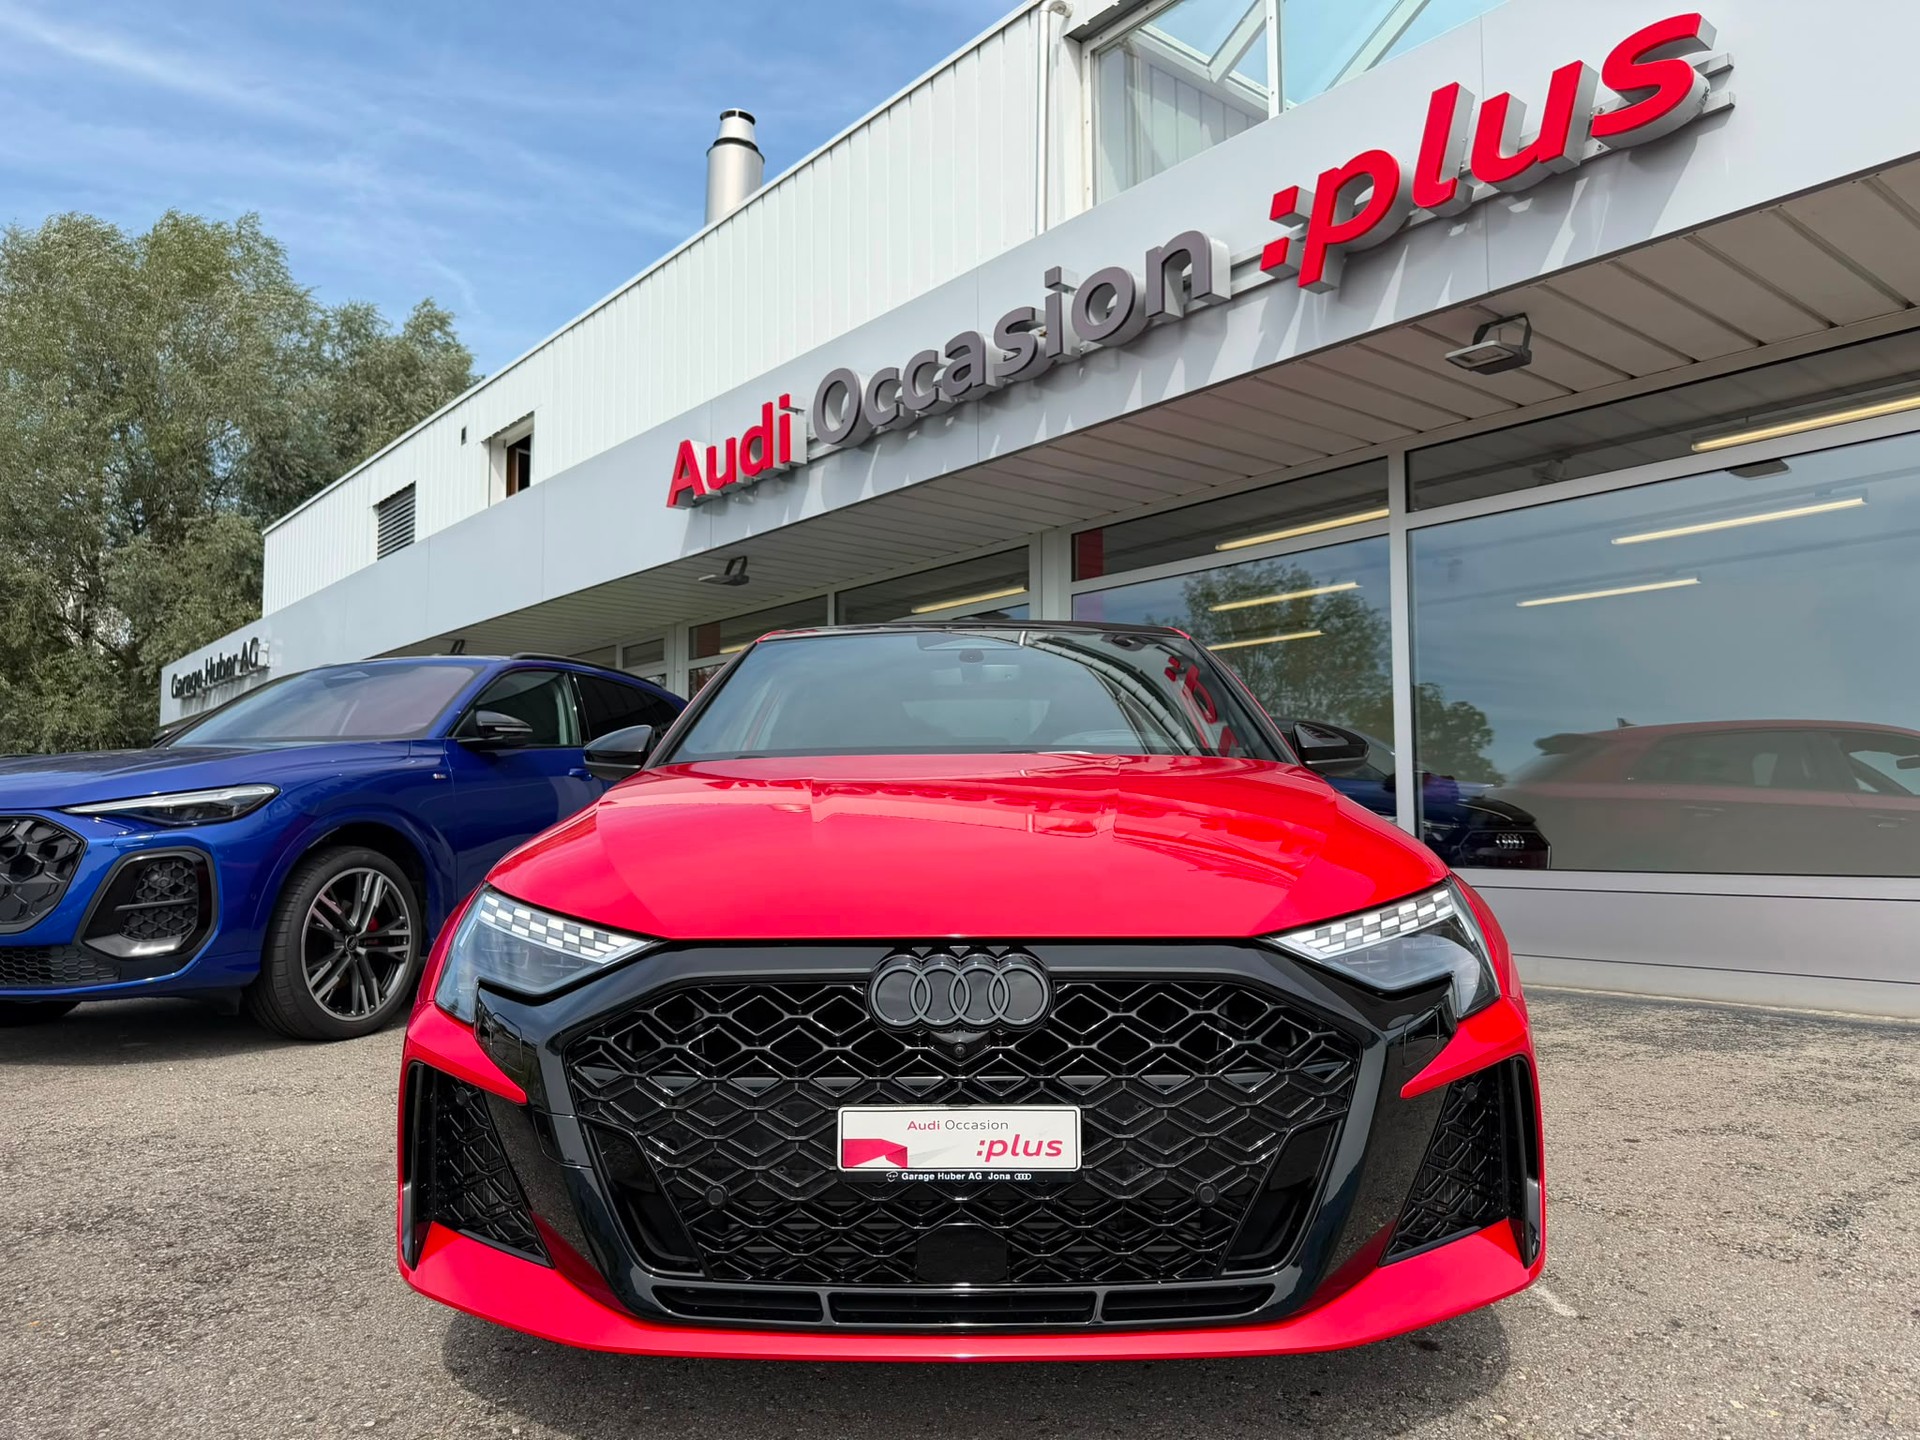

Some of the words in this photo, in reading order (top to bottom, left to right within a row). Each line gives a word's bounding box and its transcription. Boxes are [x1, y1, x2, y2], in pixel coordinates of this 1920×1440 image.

[667, 393, 802, 509] Audi
[811, 229, 1226, 446] Occasion
[171, 669, 203, 699] Garage
[204, 652, 238, 686] Huber
[239, 637, 260, 673] AG
[907, 1120, 940, 1131] Audi
[944, 1119, 1009, 1131] Occasion
[901, 1172, 935, 1183] Garage
[938, 1172, 965, 1181] Huber
[968, 1172, 983, 1181] AG
[988, 1172, 1011, 1181] Jona
